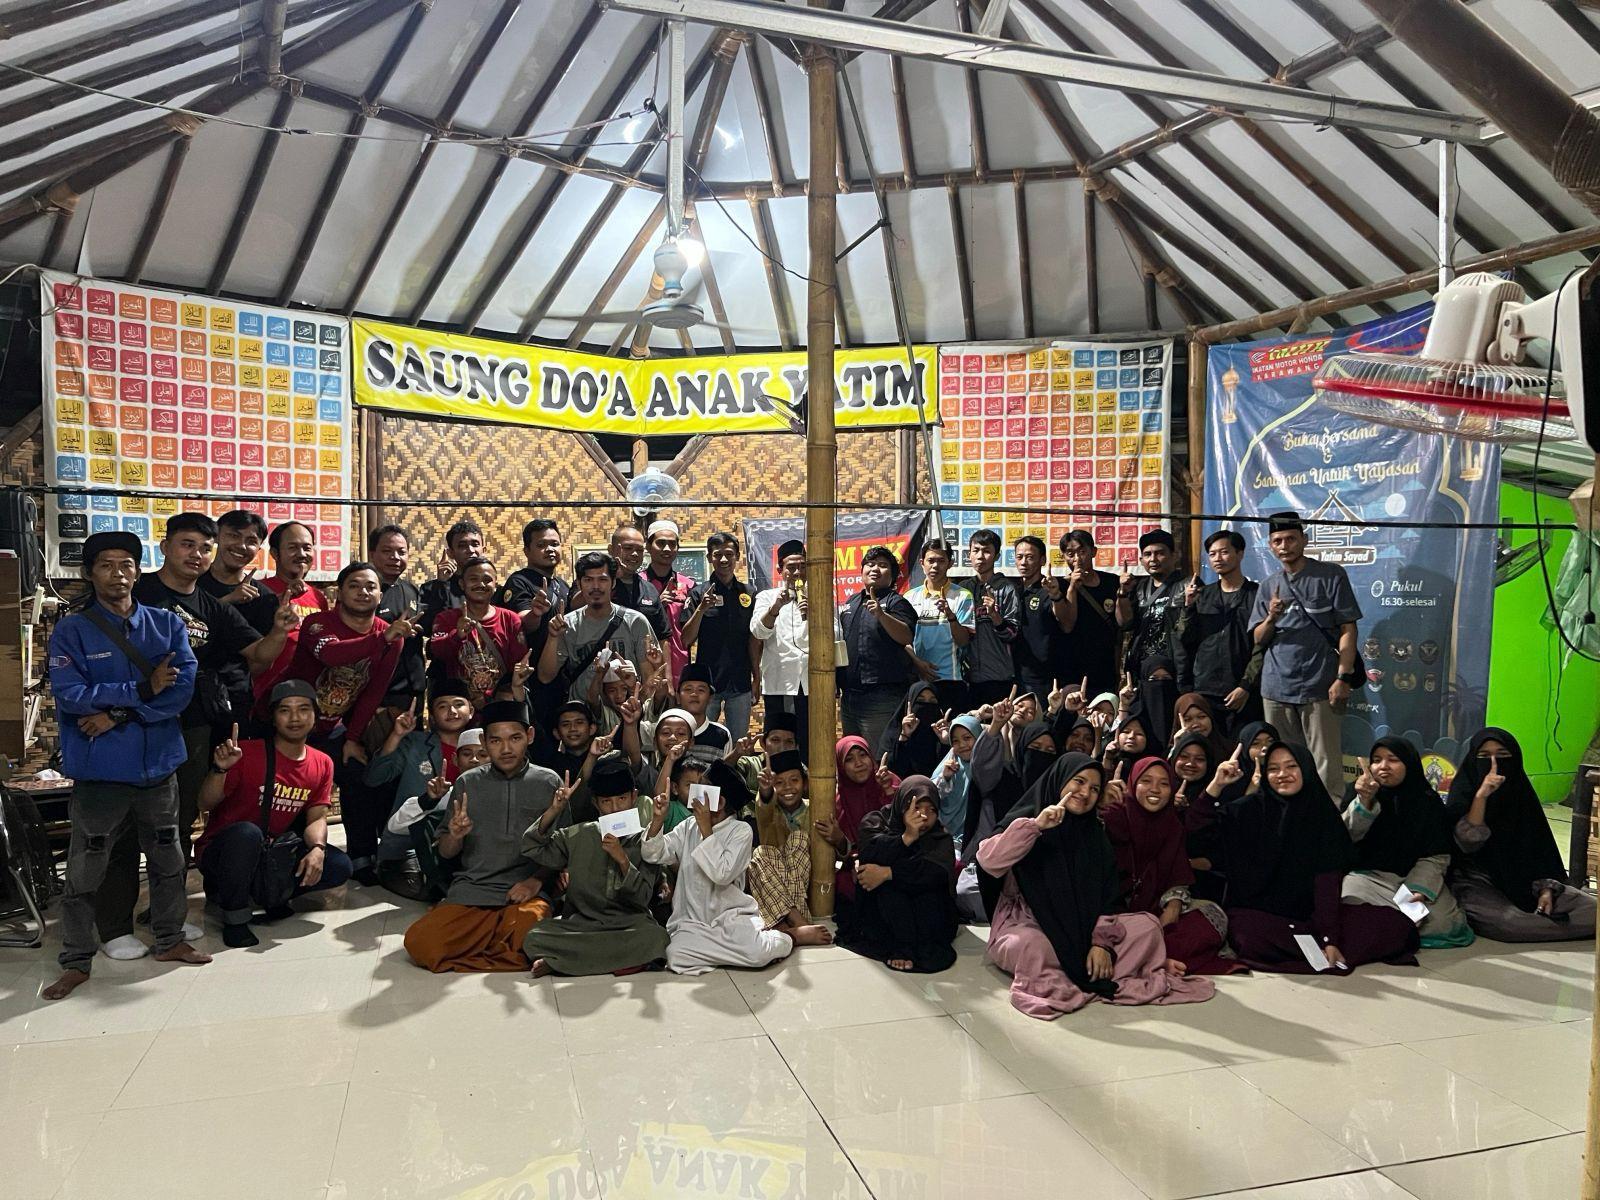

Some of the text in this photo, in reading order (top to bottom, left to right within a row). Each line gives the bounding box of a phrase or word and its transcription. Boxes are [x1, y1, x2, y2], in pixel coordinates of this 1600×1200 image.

[1298, 354, 1323, 363] HONDA
[367, 340, 530, 405] SAUNG
[541, 366, 636, 417] DO'A
[649, 371, 775, 417] ANAK
[783, 363, 926, 408] YTIM
[1390, 580, 1423, 592] Pukul
[1381, 597, 1436, 606] 16.30-selesai
